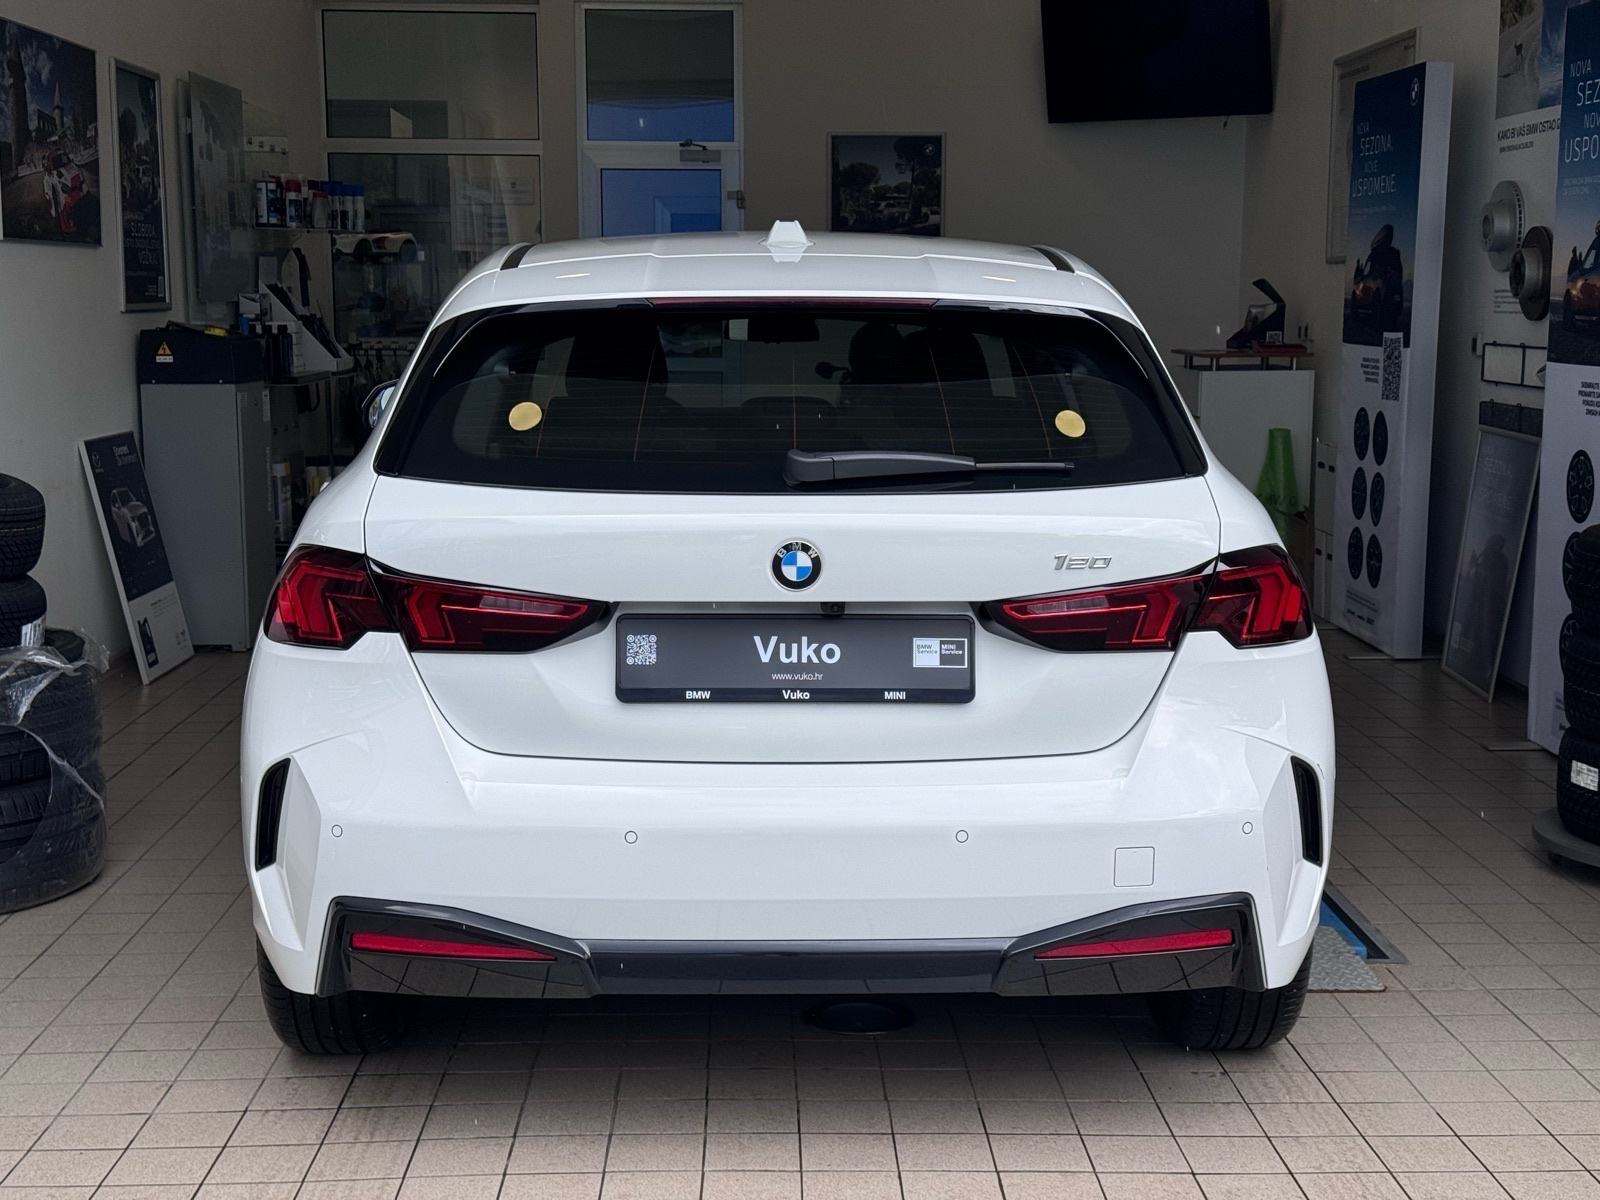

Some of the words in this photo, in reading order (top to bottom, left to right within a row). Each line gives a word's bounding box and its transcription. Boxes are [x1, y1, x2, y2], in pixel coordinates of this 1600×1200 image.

[1570, 58, 1592, 77] NOVA
[1497, 128, 1511, 141] KAKO
[1526, 123, 1538, 136] BMW
[1539, 119, 1556, 133] OSTAO
[1053, 552, 1112, 571] 120
[753, 635, 841, 664] Vuko
[771, 672, 823, 681] www.vuko.hr
[685, 690, 711, 700] BMW
[782, 689, 810, 700] Vuko
[884, 690, 906, 700] MINI
